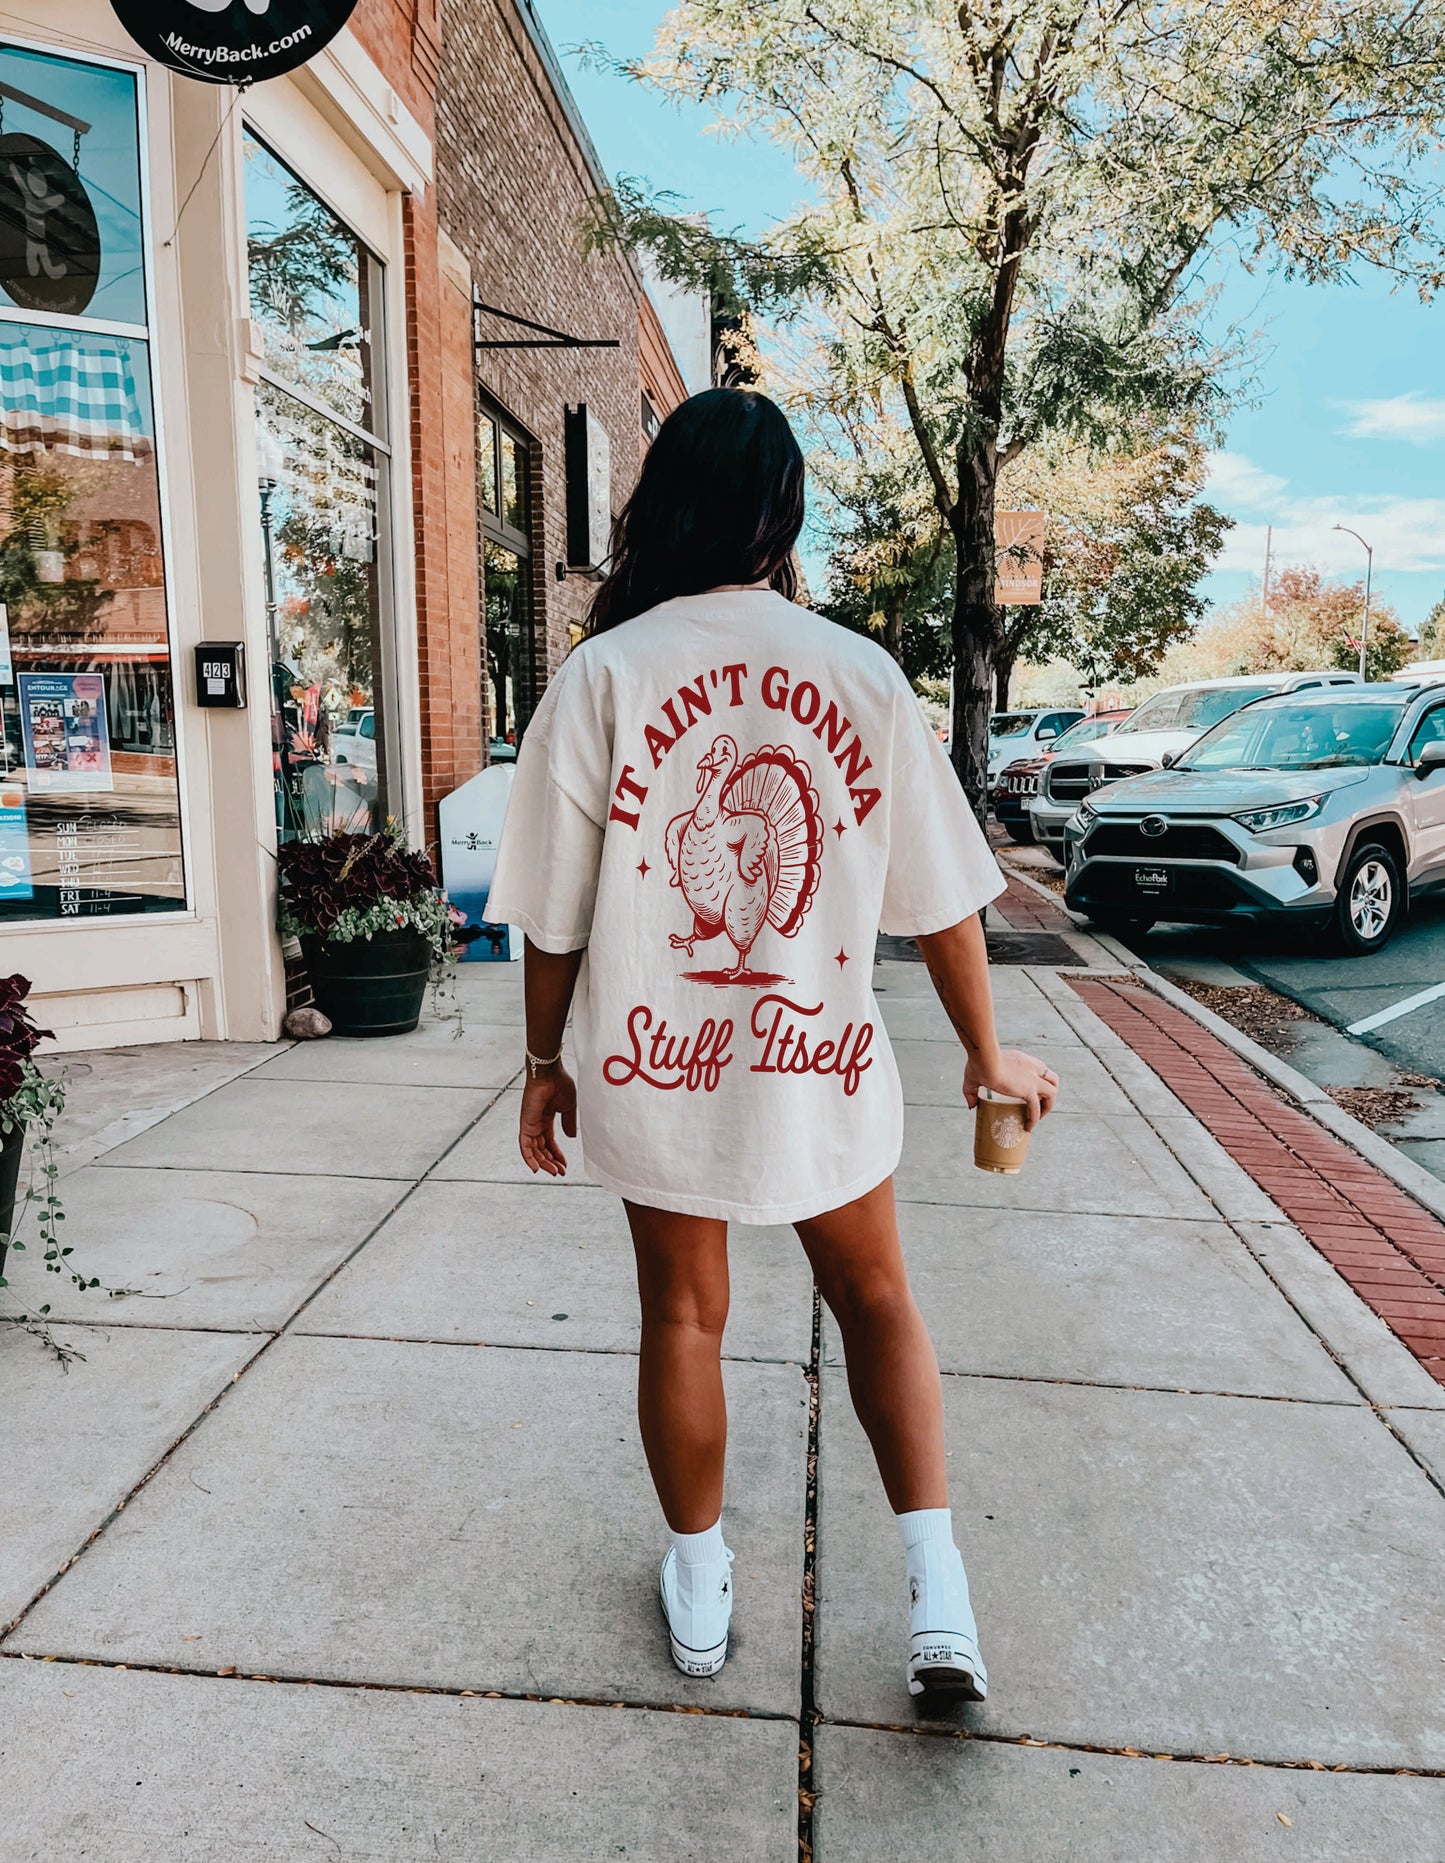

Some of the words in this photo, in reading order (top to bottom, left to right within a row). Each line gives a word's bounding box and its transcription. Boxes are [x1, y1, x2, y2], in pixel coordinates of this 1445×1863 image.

[165, 24, 312, 65] MerryBack.com
[204, 663, 230, 677] 423
[610, 766, 649, 831] IT
[644, 663, 748, 769] AIN'T
[761, 666, 882, 826] GONNA
[57, 822, 77, 833] SUN
[57, 836, 78, 847] MON
[59, 850, 78, 861] TUE
[60, 864, 80, 874] WED
[60, 877, 80, 888] THU
[1135, 873, 1168, 883] EchoPark
[60, 891, 80, 902] FRI
[91, 890, 111, 899] 11-4
[61, 904, 81, 915] SAT
[90, 904, 111, 913] 11-4
[603, 1006, 734, 1092] Stuff
[750, 993, 873, 1097] Itself
[939, 1650, 952, 1660] STAR
